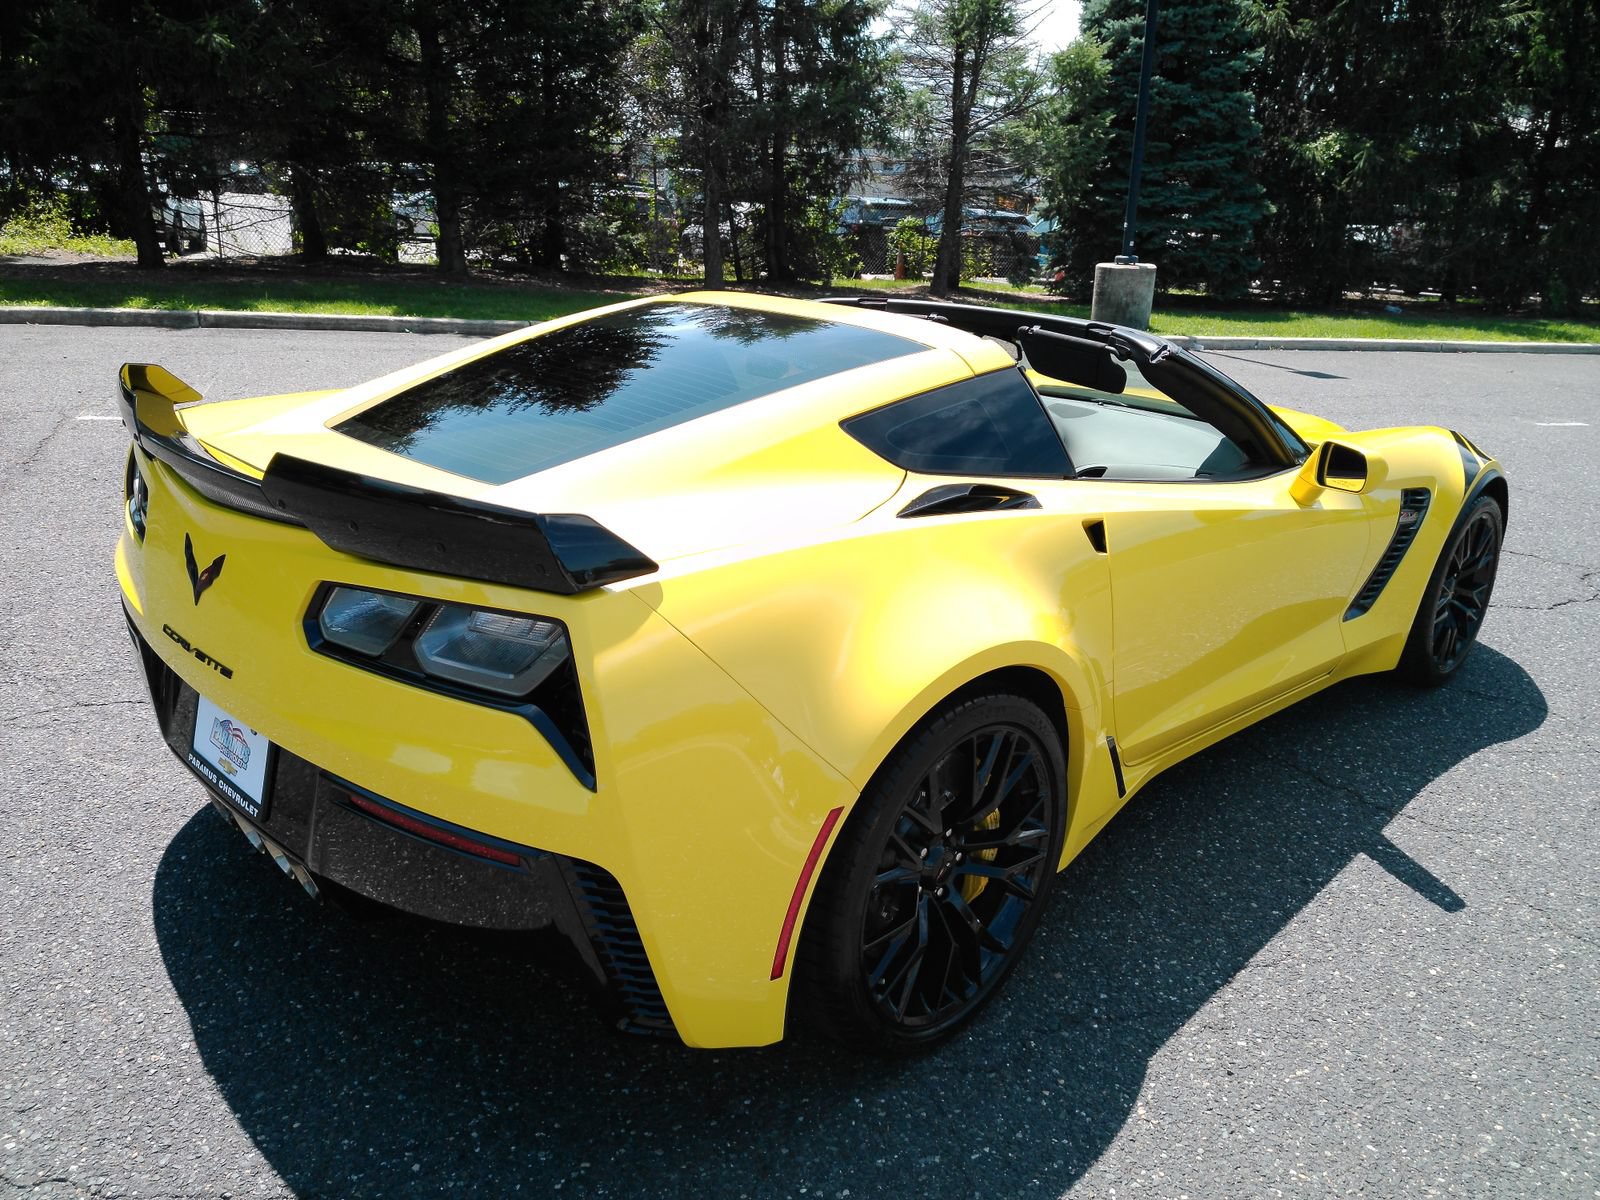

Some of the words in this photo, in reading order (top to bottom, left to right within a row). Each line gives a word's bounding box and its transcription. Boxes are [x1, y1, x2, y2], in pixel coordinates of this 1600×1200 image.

[162, 623, 234, 680] CORVETTE
[188, 753, 218, 783] PARAMUS
[218, 779, 259, 818] CHEVROLET
